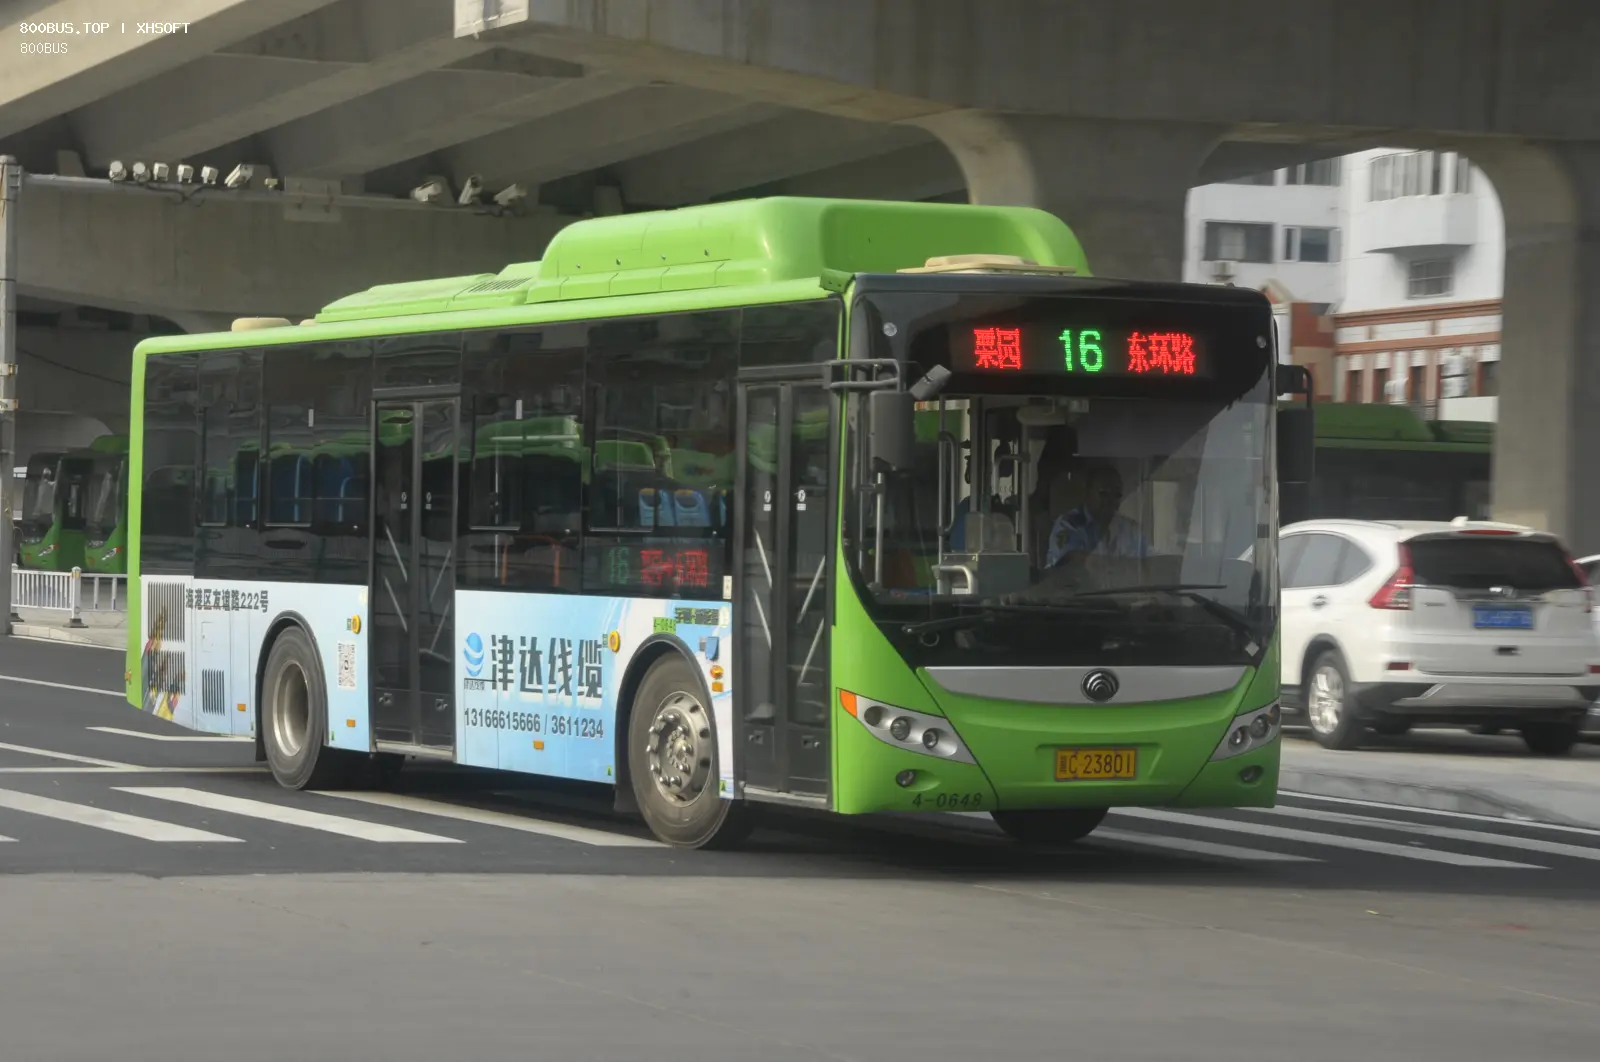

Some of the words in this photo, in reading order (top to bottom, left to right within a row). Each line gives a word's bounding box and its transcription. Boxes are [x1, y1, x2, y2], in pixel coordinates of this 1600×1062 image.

[1058, 329, 1103, 372] 16
[1127, 332, 1196, 374] 东环路
[491, 634, 603, 698] 津达线缆
[464, 707, 541, 733] 13166615666
[551, 715, 604, 739] 3611234
